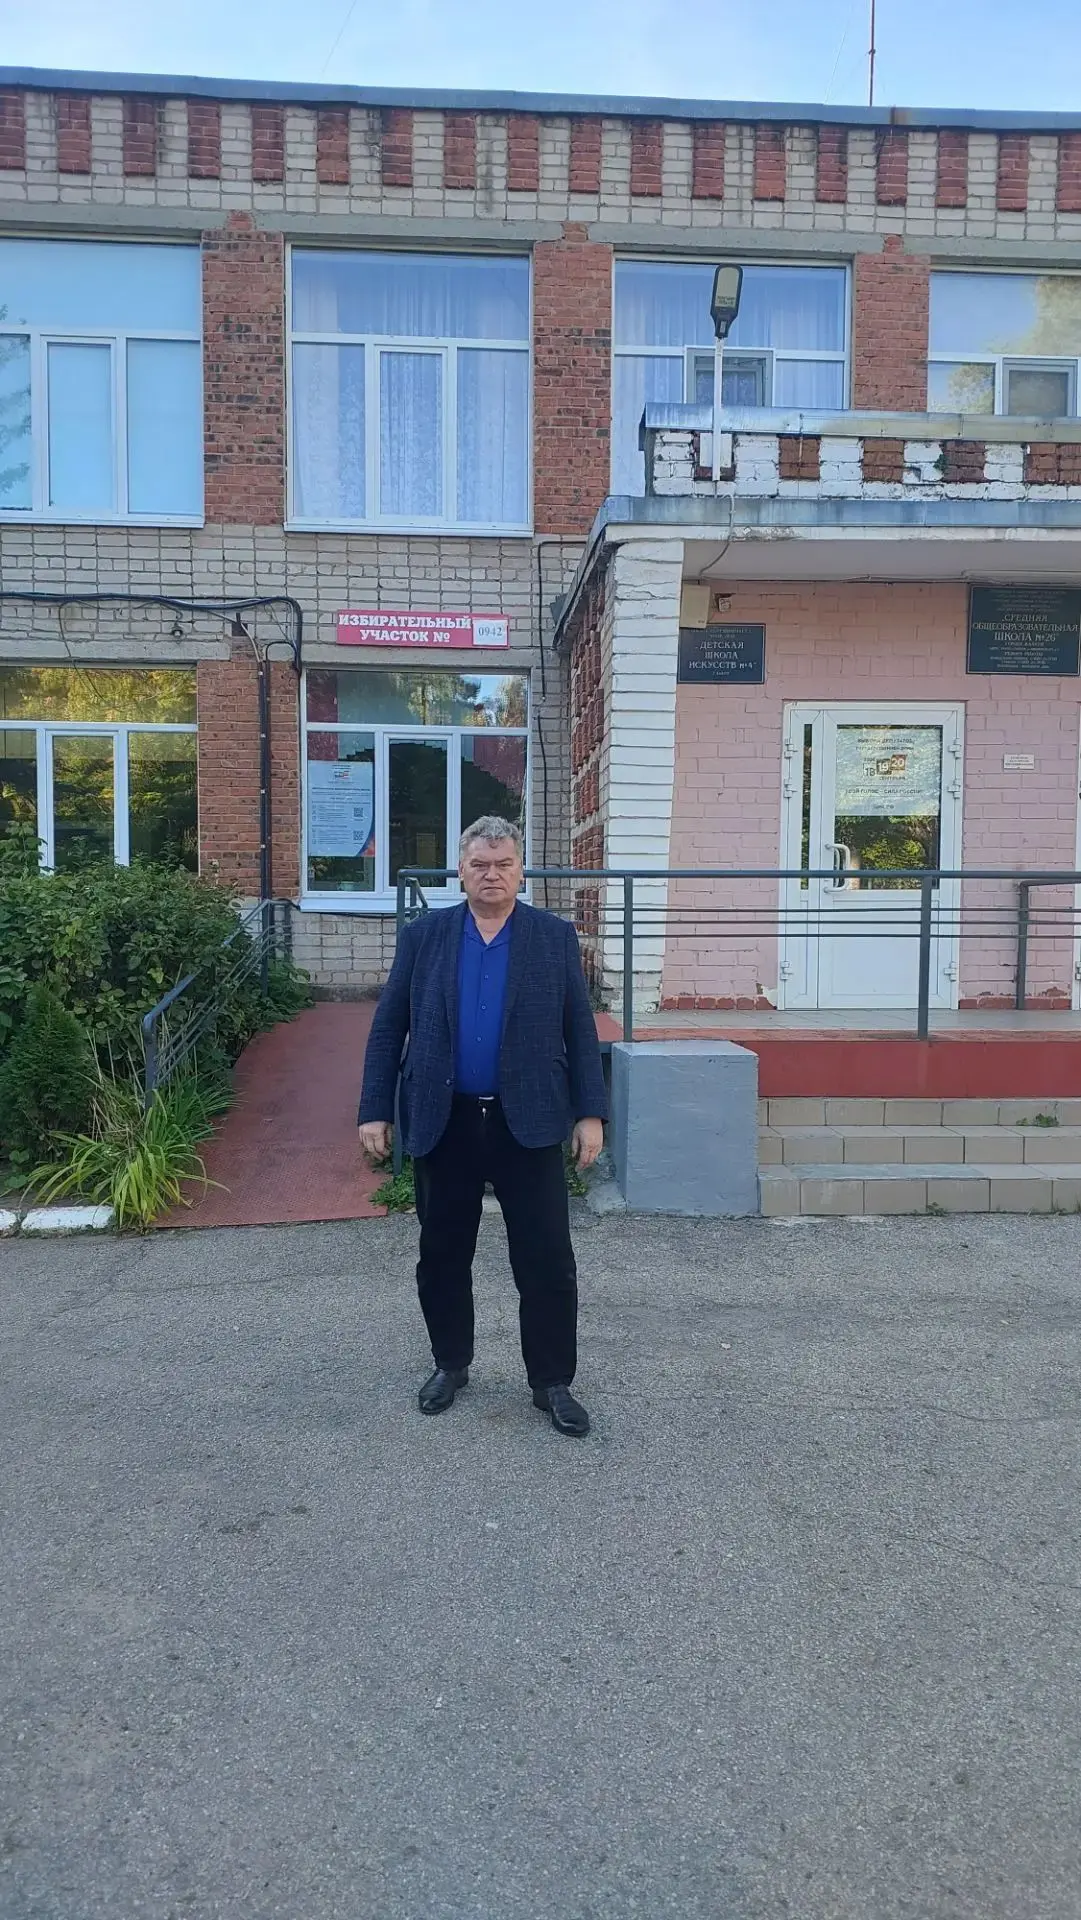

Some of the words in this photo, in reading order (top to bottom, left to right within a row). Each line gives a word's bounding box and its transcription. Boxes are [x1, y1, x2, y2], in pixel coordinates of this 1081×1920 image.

[338, 614, 472, 629] ИЗБИРАТЕЛЬНЫЙ
[478, 626, 504, 637] 0942
[972, 622, 1079, 632] ОБЩЕОБРАЗОВАТЕЛЬНАЯ
[360, 629, 429, 642] УЧАСТОК
[433, 631, 451, 643] №
[994, 632, 1032, 641] ШКОЛА
[704, 651, 739, 660] ШКОЛА
[688, 661, 737, 669] ИСКУССТВ
[865, 767, 876, 777] 18
[877, 762, 889, 772] 19
[891, 757, 905, 768] 20
